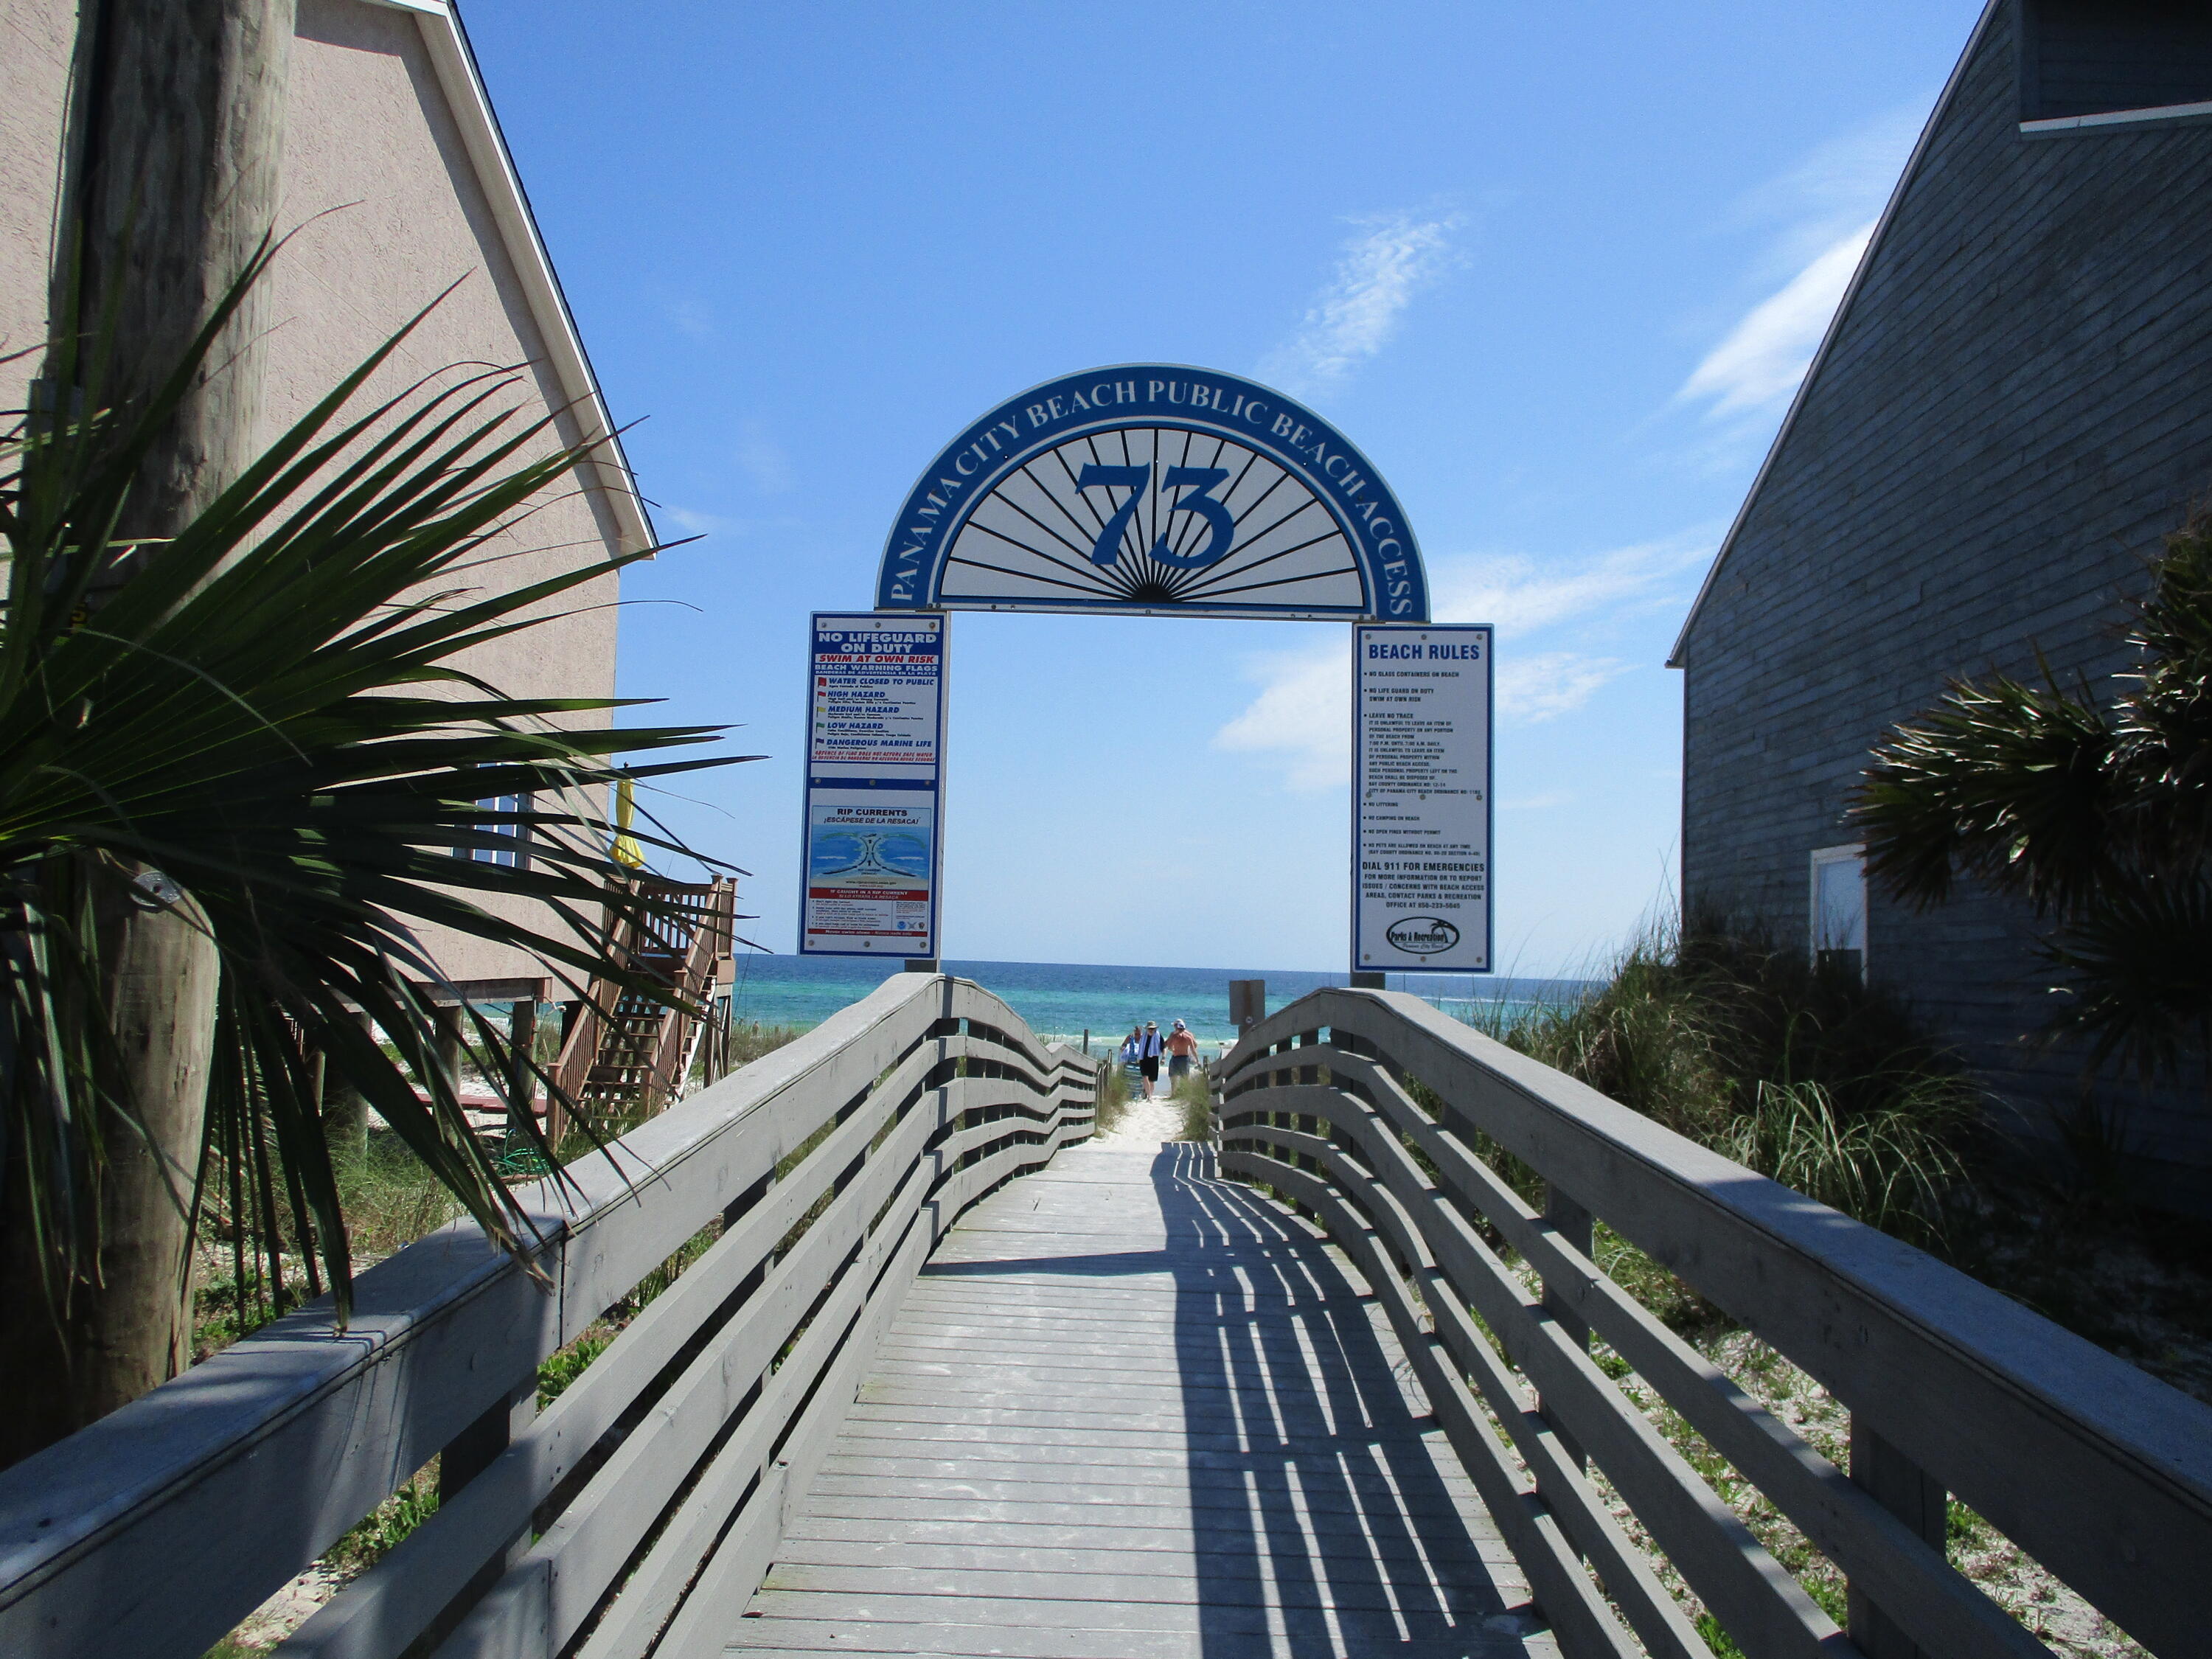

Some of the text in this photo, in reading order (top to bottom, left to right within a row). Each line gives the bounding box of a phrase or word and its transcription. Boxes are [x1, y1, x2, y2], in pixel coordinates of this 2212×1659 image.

[891, 380, 1412, 615] PANAMA CITY BEACH PUBLIC BEACH ACCESS
[1074, 462, 1235, 570] 73
[819, 633, 936, 643] NO LIFEGUARD
[841, 643, 913, 653] ON DUTY
[1369, 644, 1480, 660] BEACH RULES
[1363, 862, 1484, 872] DIAL 911 FOR EMERGENCIES
[1391, 932, 1407, 942] Parks
[1414, 932, 1444, 942] Recreation
